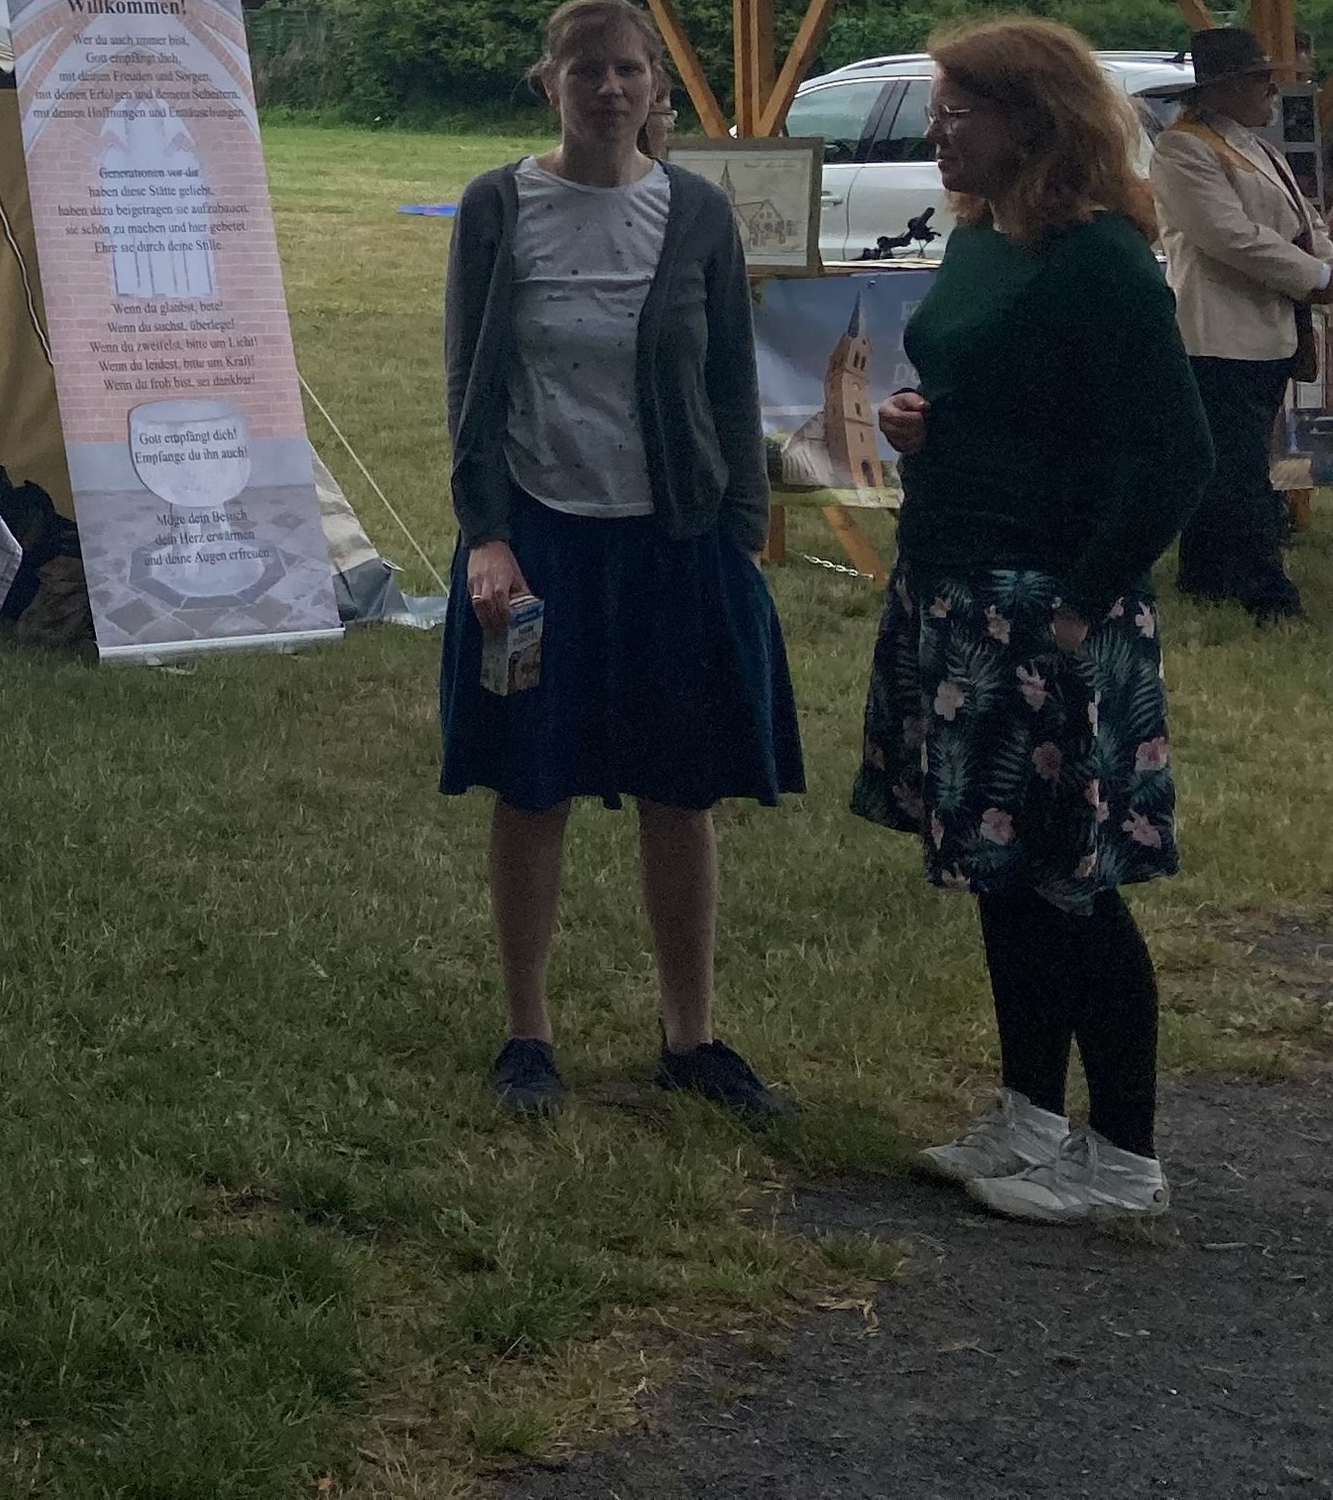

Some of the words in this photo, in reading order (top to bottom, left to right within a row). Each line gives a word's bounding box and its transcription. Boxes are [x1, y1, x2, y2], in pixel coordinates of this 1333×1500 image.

[73, 34, 92, 46] Wer
[96, 35, 107, 46] du
[111, 35, 134, 46] auch
[137, 35, 166, 46] immer
[86, 52, 108, 64] Gott
[59, 71, 75, 81] mit
[113, 71, 156, 82] Freuden
[158, 71, 173, 81] und
[35, 89, 51, 100] mit
[89, 89, 133, 103] Erfolgen
[135, 89, 152, 100] und
[33, 108, 49, 119] mit
[87, 108, 146, 121] Hoffnungen
[149, 108, 166, 119] und
[99, 167, 165, 179] Generationen
[167, 168, 183, 177] vor
[185, 167, 199, 177] dir
[88, 185, 118, 197] haben
[121, 185, 146, 197] diese
[58, 205, 88, 216] haben
[90, 205, 114, 216] dazu
[116, 204, 173, 218] beigetragen
[176, 205, 189, 215] sie
[65, 225, 80, 235] sie
[113, 225, 126, 235] zu
[128, 223, 166, 234] machen
[169, 222, 186, 233] und
[189, 222, 207, 233] hier
[95, 242, 118, 253] Ehre
[121, 242, 135, 252] sie
[137, 241, 165, 252] durch
[168, 240, 194, 251] deine
[112, 303, 142, 315] Wenn
[144, 303, 157, 313] du
[107, 322, 136, 333] Wenn
[138, 321, 152, 332] du
[89, 341, 119, 353] Wenn
[121, 341, 134, 352] du
[186, 339, 208, 350] bitte
[210, 339, 226, 349] um
[228, 336, 259, 348] Licht!
[99, 360, 128, 372] Wenn
[129, 360, 142, 371] du
[183, 358, 204, 369] bitte
[207, 358, 223, 368] um
[225, 355, 255, 368] Kraft!
[103, 379, 133, 391] Wenn
[135, 379, 148, 390] du
[150, 377, 172, 390] froh
[197, 376, 211, 387] sei
[212, 374, 256, 387] dankbar!
[139, 432, 162, 445] Gott
[164, 430, 211, 446] empfängt
[213, 428, 237, 441] dich!
[188, 449, 201, 461] du
[203, 448, 219, 460] ihn
[221, 446, 248, 459] auch!
[156, 514, 186, 528] Möge
[188, 512, 210, 524] dein
[212, 509, 248, 523] Besuch
[155, 534, 177, 546] dein
[179, 532, 205, 545] Herz
[206, 530, 255, 542] erwärmen
[143, 555, 163, 566] und
[165, 554, 192, 565] deine
[194, 551, 227, 565] Augen
